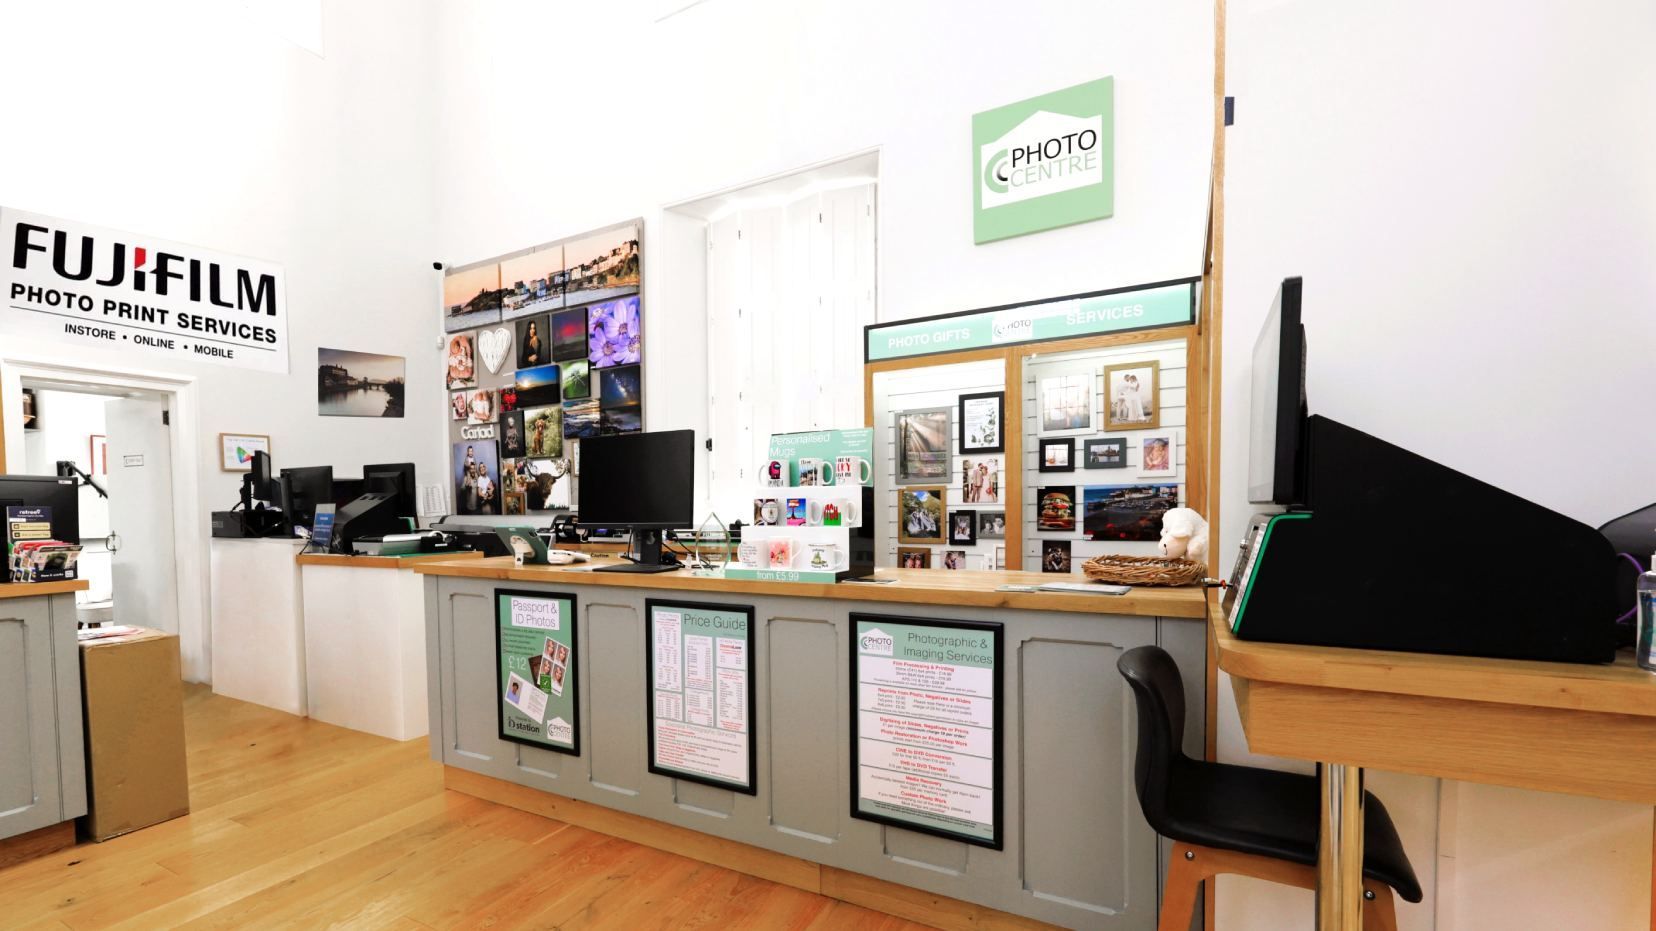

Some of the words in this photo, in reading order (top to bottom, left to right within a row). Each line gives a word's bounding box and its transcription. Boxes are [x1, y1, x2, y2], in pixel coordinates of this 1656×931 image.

[1012, 129, 1097, 168] PHOTO
[1010, 151, 1097, 188] CENTRE
[12, 222, 277, 316] FUJIFILM
[10, 283, 94, 312] PHOTO
[103, 299, 169, 325] PRINT
[177, 312, 277, 344] SERVICES
[1066, 304, 1144, 325] SERVICES
[64, 323, 116, 340] INSTORE
[134, 335, 175, 350] ONLINE
[194, 344, 234, 359] MOBILE
[888, 334, 931, 349] PHOTO
[932, 328, 971, 344] GIFTS
[771, 432, 830, 446] Personalised
[769, 447, 796, 458] Mugs
[757, 570, 775, 580] from
[776, 570, 800, 582] £5.99
[512, 600, 549, 614] Passport
[550, 602, 557, 614] &
[515, 613, 525, 624] ID
[526, 614, 556, 628] Photos
[683, 613, 711, 627] Price
[713, 616, 746, 630] Guide
[868, 637, 892, 646] PHOTO
[868, 644, 892, 652] CENTRE
[907, 632, 977, 648] Photographic
[979, 638, 988, 649] &
[508, 655, 527, 671] £12
[903, 646, 944, 661] Imaging
[946, 650, 993, 665] Services
[516, 722, 540, 734] station
